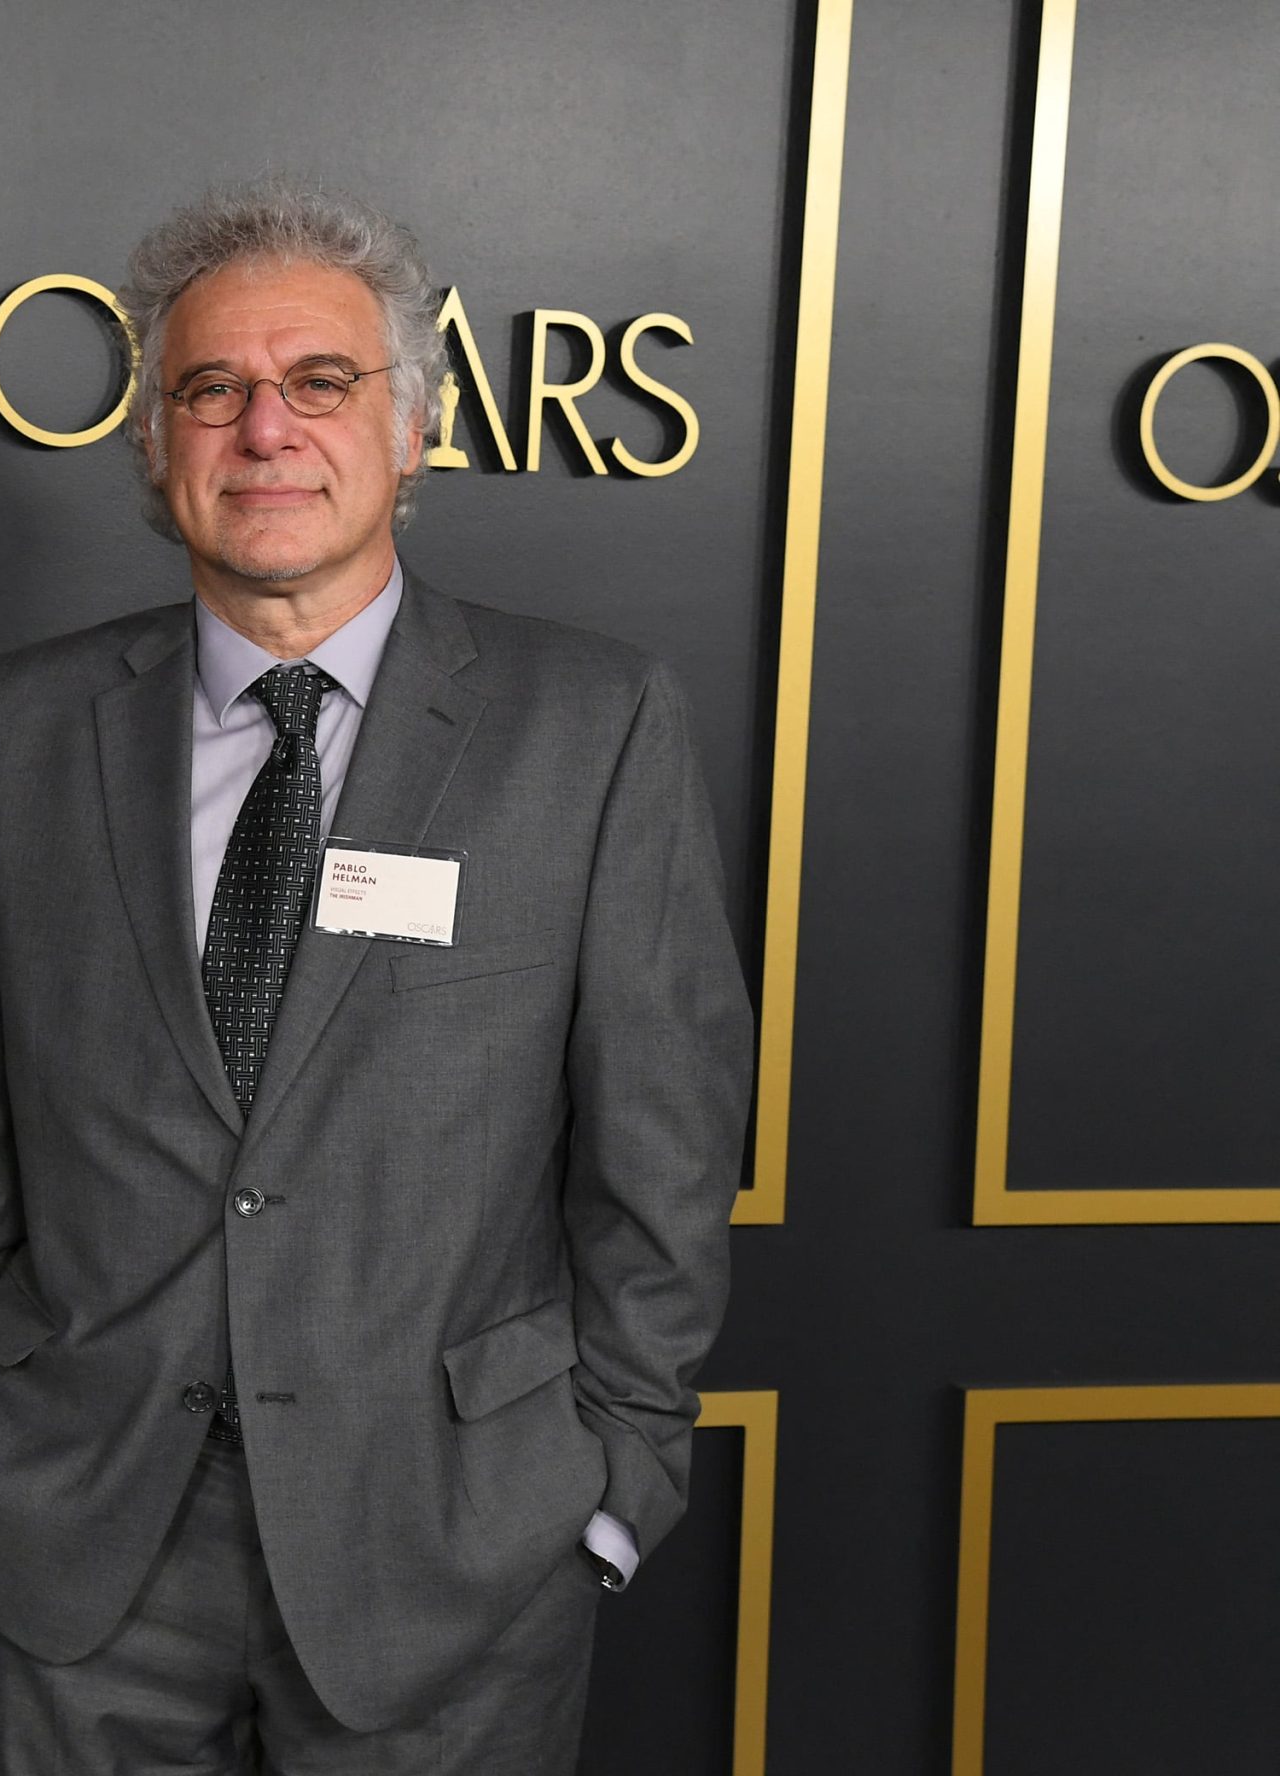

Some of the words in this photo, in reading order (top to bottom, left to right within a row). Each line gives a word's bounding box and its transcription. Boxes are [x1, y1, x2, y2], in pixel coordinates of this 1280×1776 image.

[1139, 342, 1280, 502] O
[333, 862, 367, 874] PABLO
[332, 873, 377, 885] HELMAN
[407, 921, 448, 936] OSCARS
